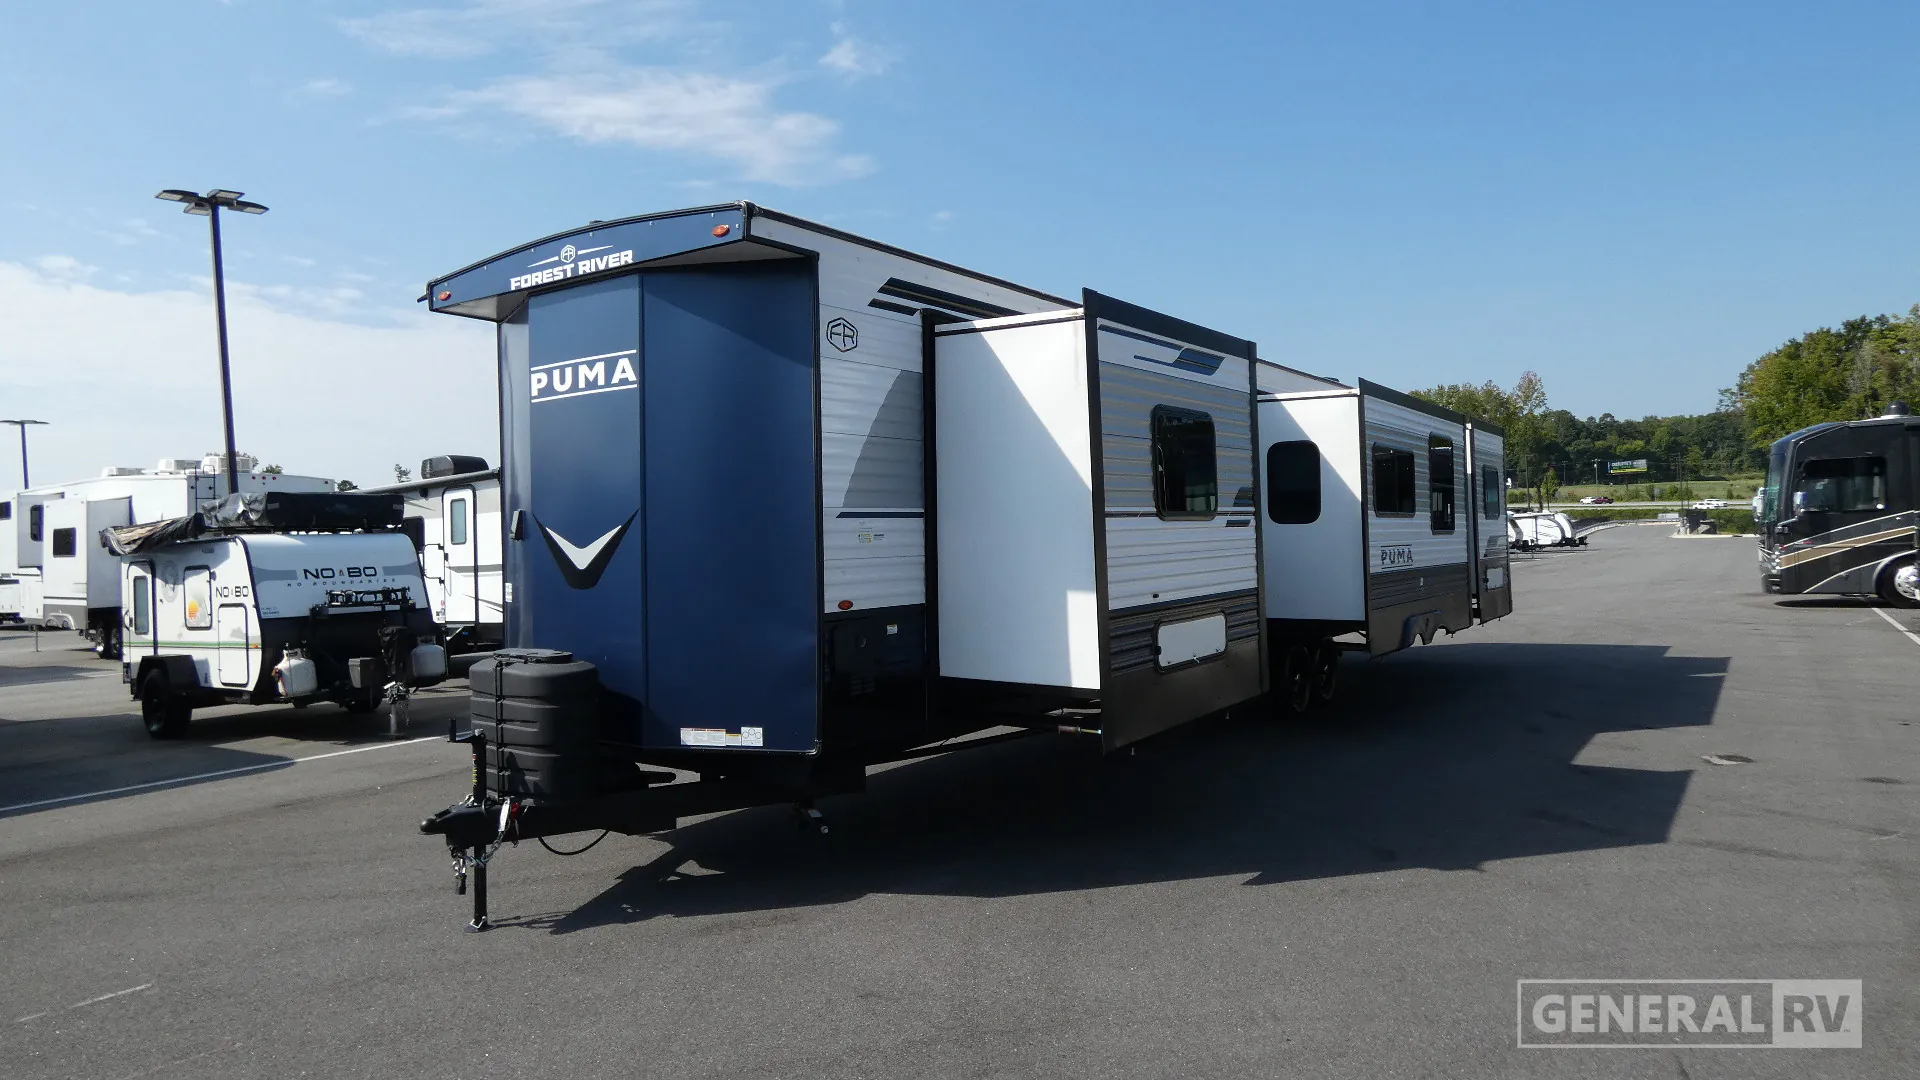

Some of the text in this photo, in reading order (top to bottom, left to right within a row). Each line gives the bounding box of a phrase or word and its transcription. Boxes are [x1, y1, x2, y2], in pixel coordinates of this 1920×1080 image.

[510, 250, 634, 290] FOREST RIVER
[531, 357, 637, 397] PUMA
[1381, 547, 1414, 566] PUMA
